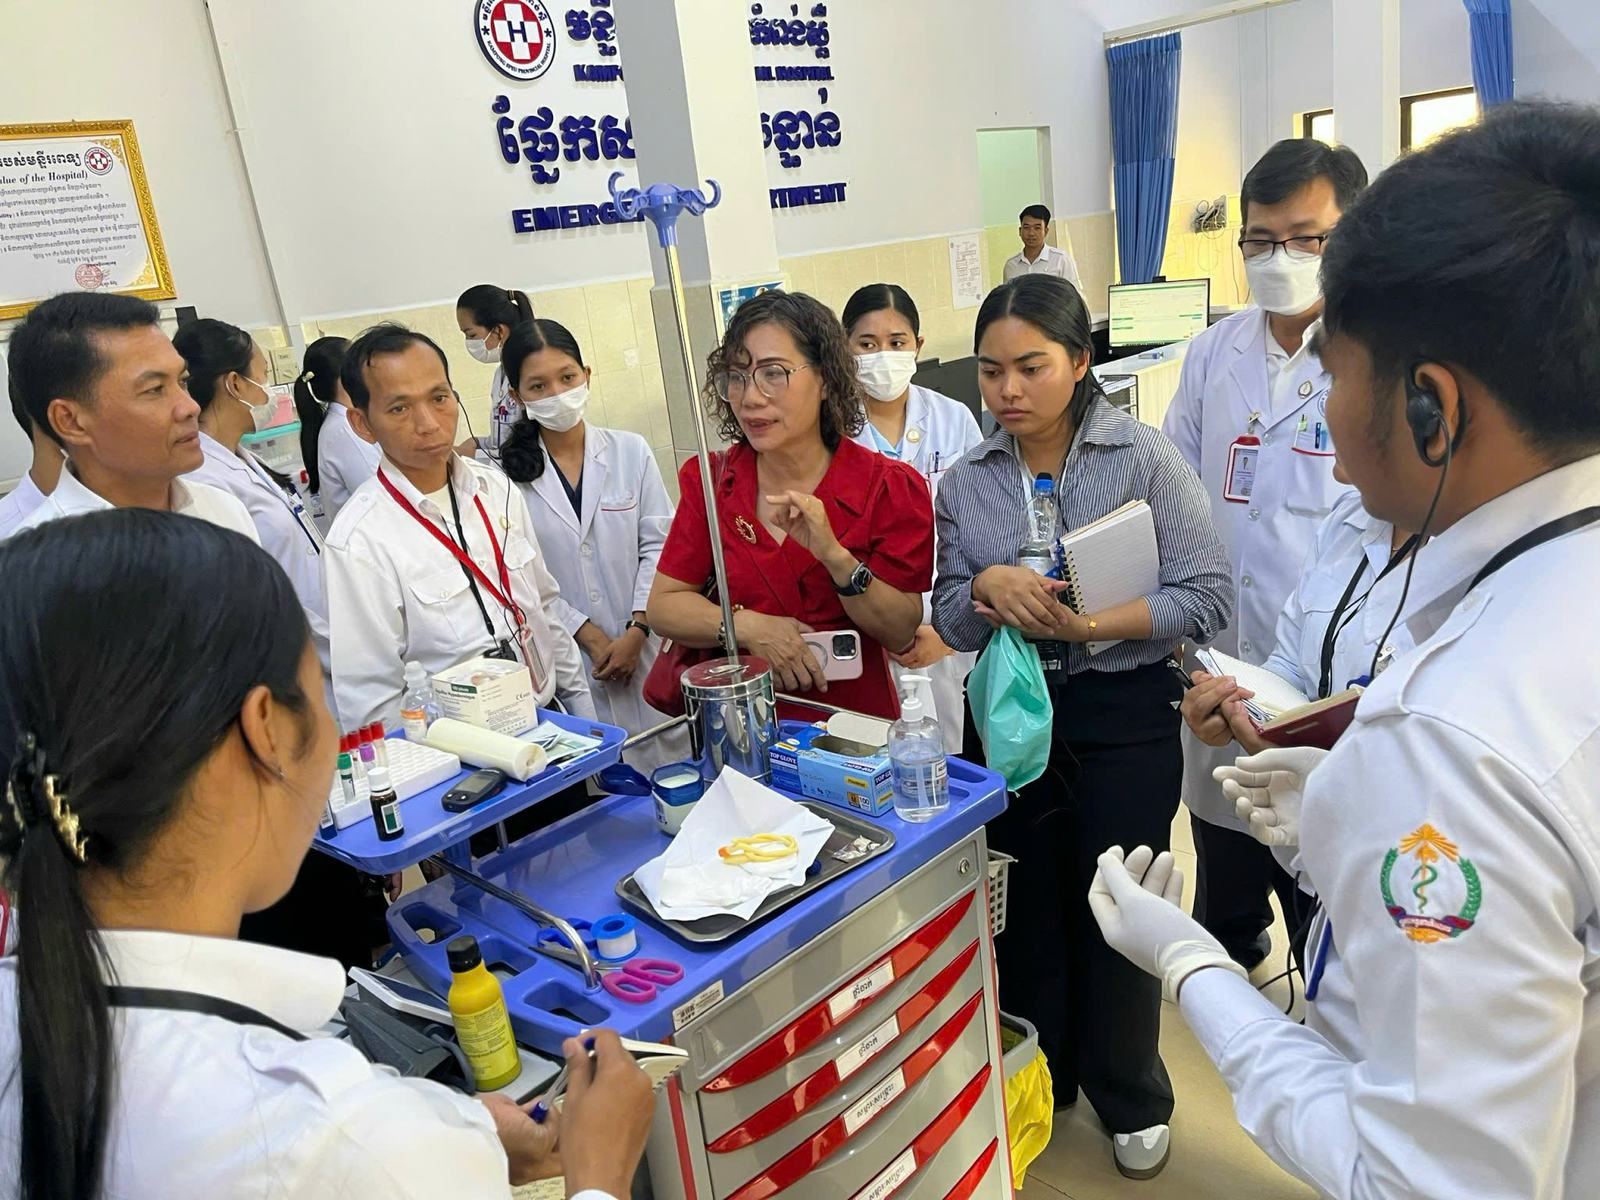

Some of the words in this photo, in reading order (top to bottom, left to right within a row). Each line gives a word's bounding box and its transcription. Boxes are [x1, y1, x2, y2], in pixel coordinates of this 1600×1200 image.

[507, 21, 528, 42] H
[573, 64, 625, 82] KAMP
[775, 66, 835, 81] HOSPITAL
[20, 174, 29, 185] of
[31, 173, 46, 182] the
[49, 170, 88, 182] Hospital)
[769, 183, 847, 209] RTMENT
